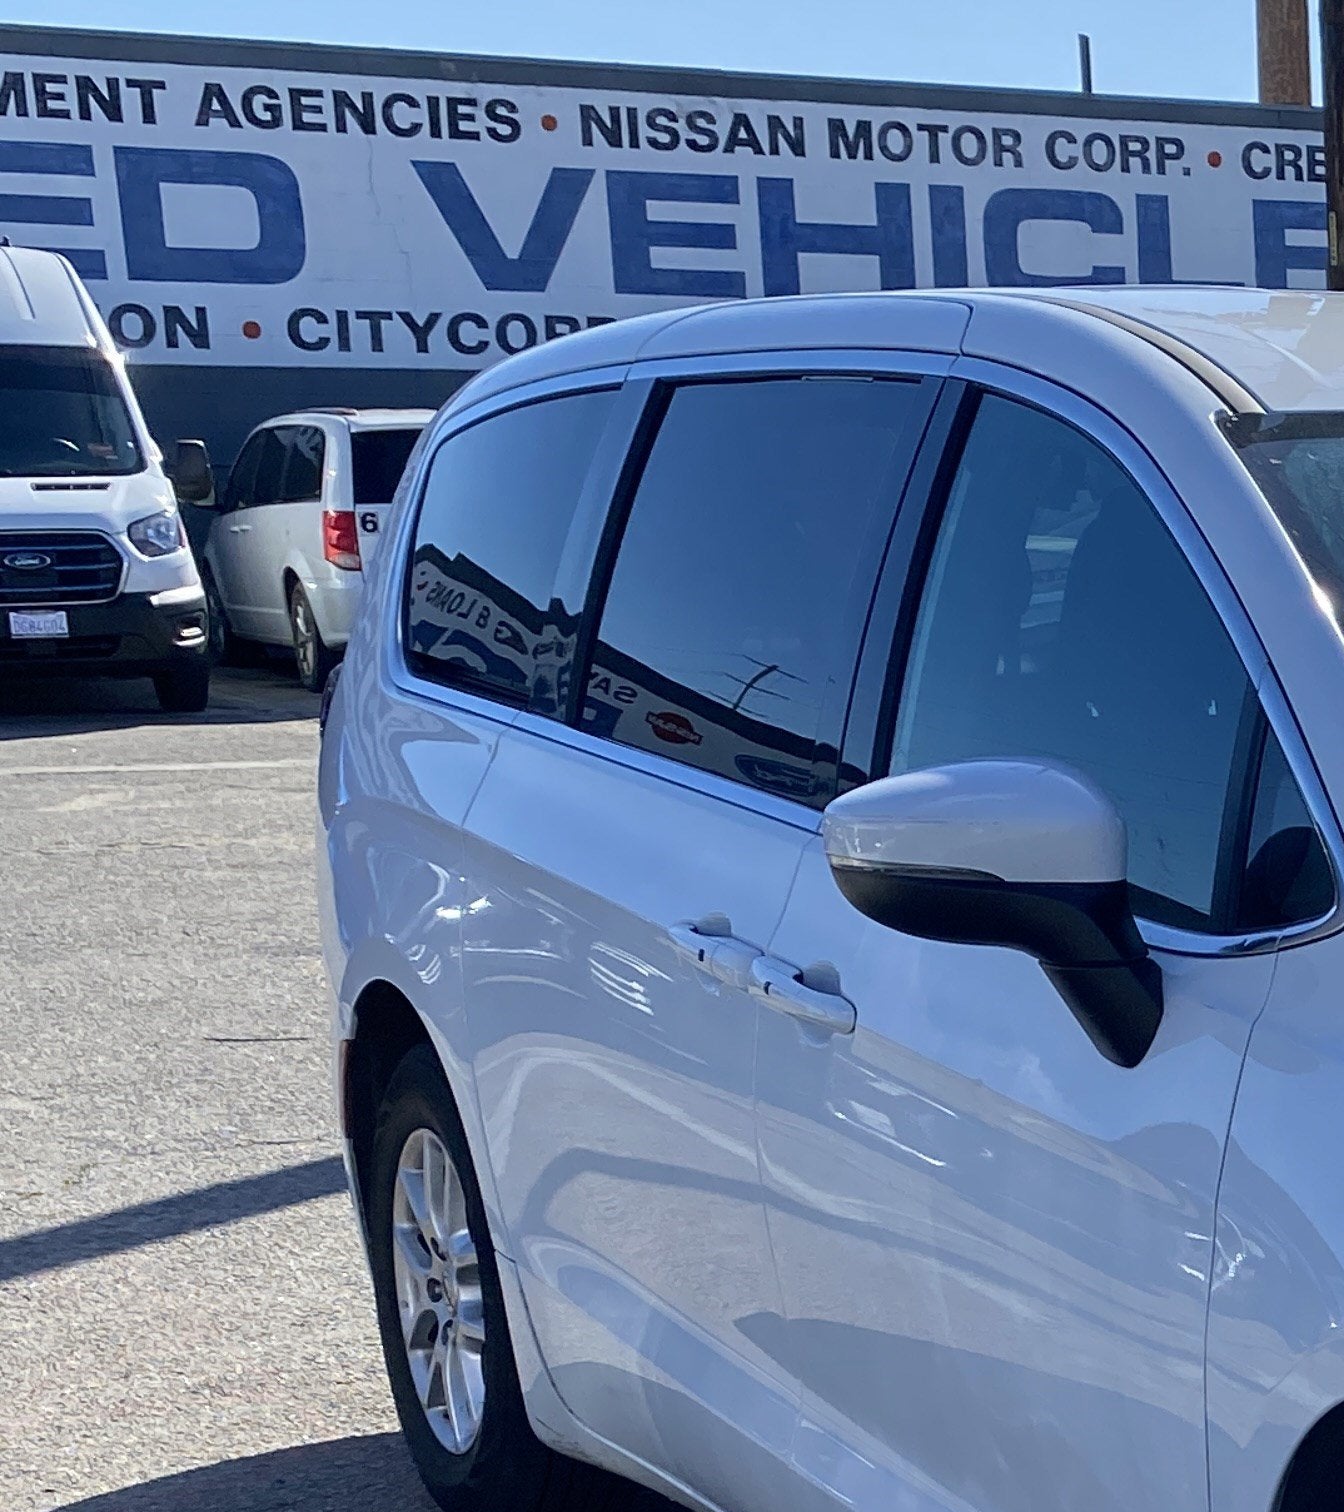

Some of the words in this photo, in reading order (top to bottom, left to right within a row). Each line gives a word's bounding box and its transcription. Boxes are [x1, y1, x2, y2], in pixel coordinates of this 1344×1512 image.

[0, 71, 167, 125] MENT
[195, 82, 522, 143] AGENCIES
[579, 104, 807, 157] NISSAN
[827, 117, 1022, 168] MOTOR
[1044, 129, 1192, 177] CORP.
[1241, 141, 1327, 183] CRE
[0, 140, 306, 285] ED
[97, 303, 211, 350] ON
[286, 307, 617, 355] CITYCO
[360, 512, 379, 533] 6
